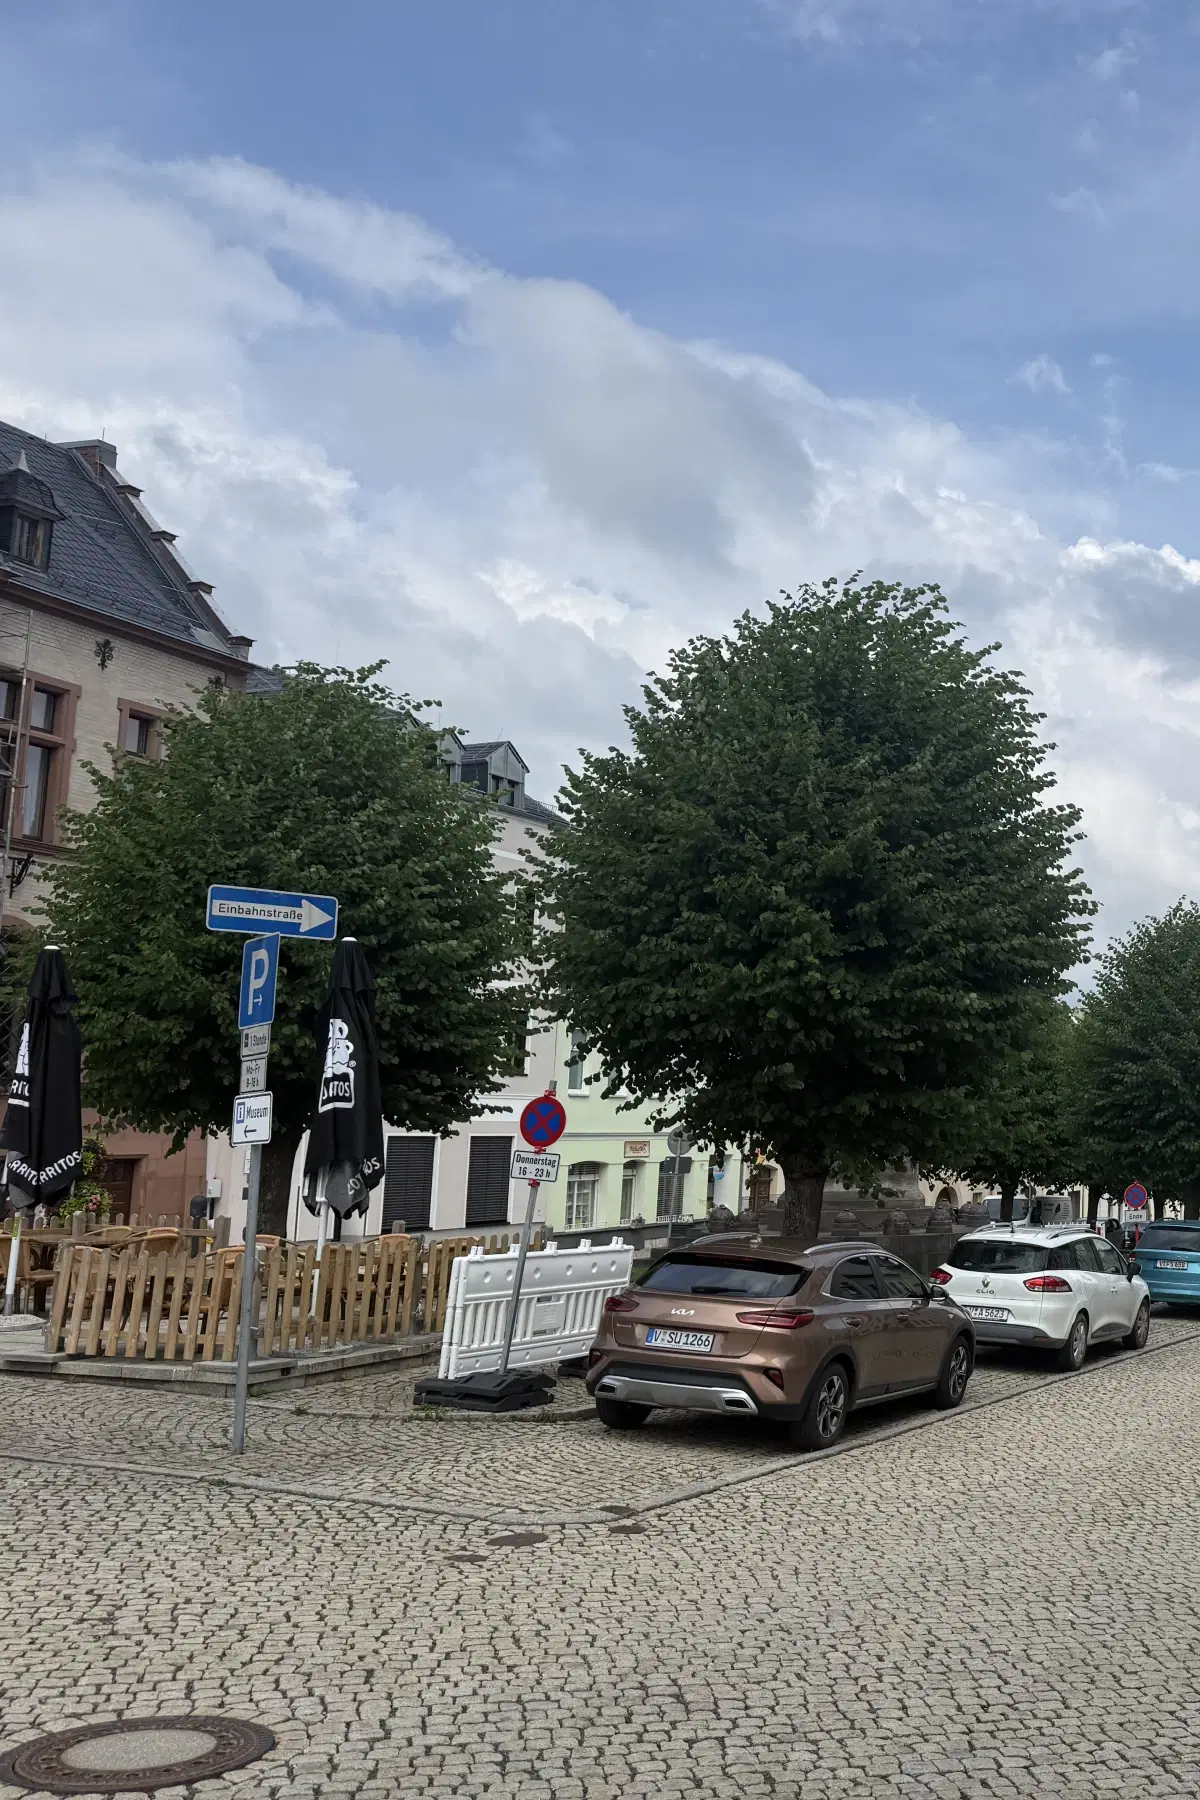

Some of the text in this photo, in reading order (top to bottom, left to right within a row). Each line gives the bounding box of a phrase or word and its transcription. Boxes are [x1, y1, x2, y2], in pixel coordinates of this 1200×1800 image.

[218, 903, 303, 920] Einbahnstraße
[247, 948, 270, 1016] P
[246, 1105, 268, 1119] Museum
[39, 1150, 81, 1185] RRITOS
[515, 1154, 557, 1168] Donnerstag
[519, 1166, 528, 1176] 16
[534, 1168, 544, 1177] 23
[545, 1169, 551, 1178] h
[670, 1308, 695, 1316] KIA
[985, 1308, 1005, 1319] 5623
[654, 1330, 662, 1342] V
[683, 1333, 711, 1347] 1266
